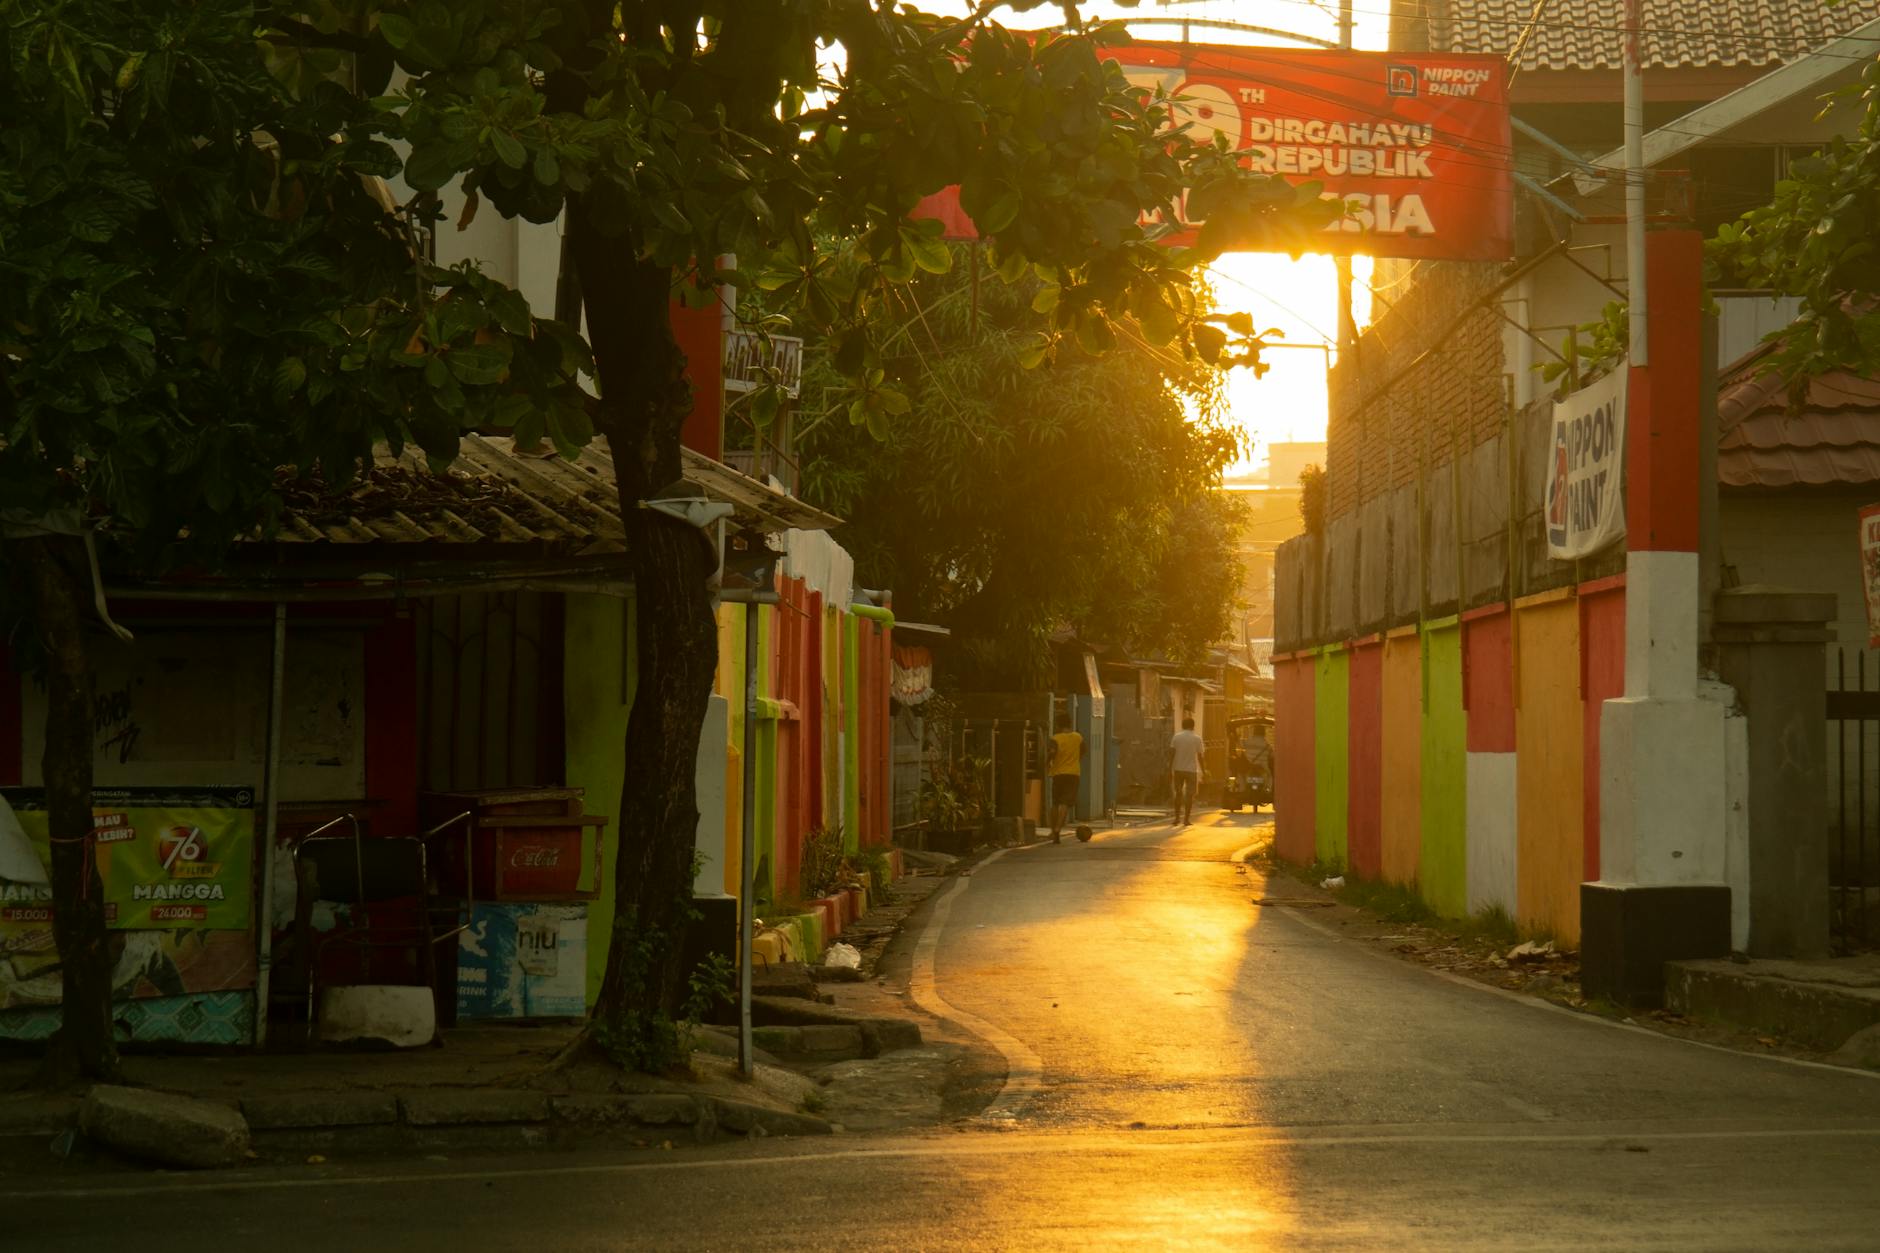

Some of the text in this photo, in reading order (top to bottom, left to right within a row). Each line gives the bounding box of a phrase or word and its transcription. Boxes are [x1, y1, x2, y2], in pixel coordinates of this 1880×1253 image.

[1423, 67, 1490, 82] NIPPON
[1239, 88, 1266, 104] TH
[1428, 82, 1480, 97] PAINT
[1251, 117, 1433, 147] DIRGAHAYU
[1251, 144, 1434, 178] REPUBLIK
[163, 827, 200, 871] 76
[133, 883, 225, 901] MANGGA
[457, 985, 488, 997] RINK
